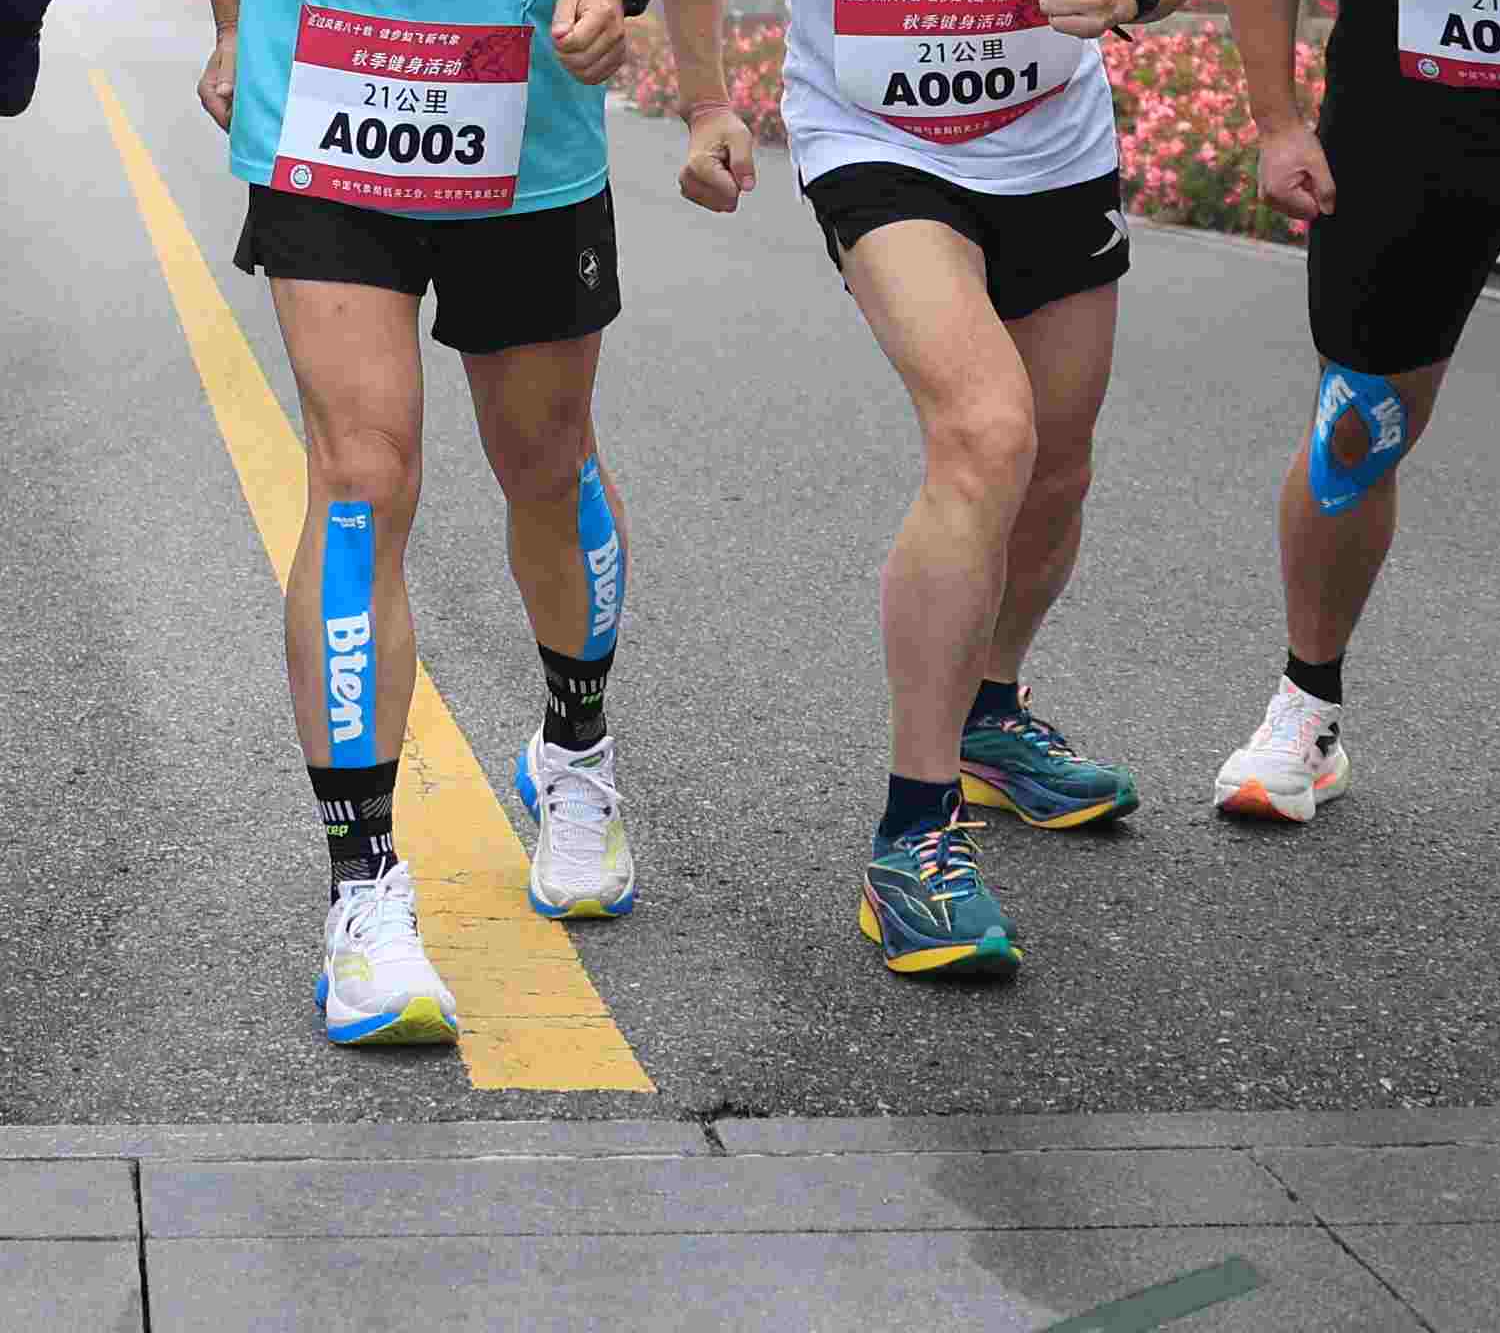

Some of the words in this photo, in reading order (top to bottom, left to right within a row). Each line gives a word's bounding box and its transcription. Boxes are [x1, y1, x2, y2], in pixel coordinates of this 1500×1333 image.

[352, 49, 462, 76] 秋季健身活动
[918, 38, 1006, 64] 21公里
[364, 83, 448, 114] 21公里
[882, 61, 1039, 107] A0001
[319, 112, 486, 165] A0003
[325, 610, 373, 743] Bten
